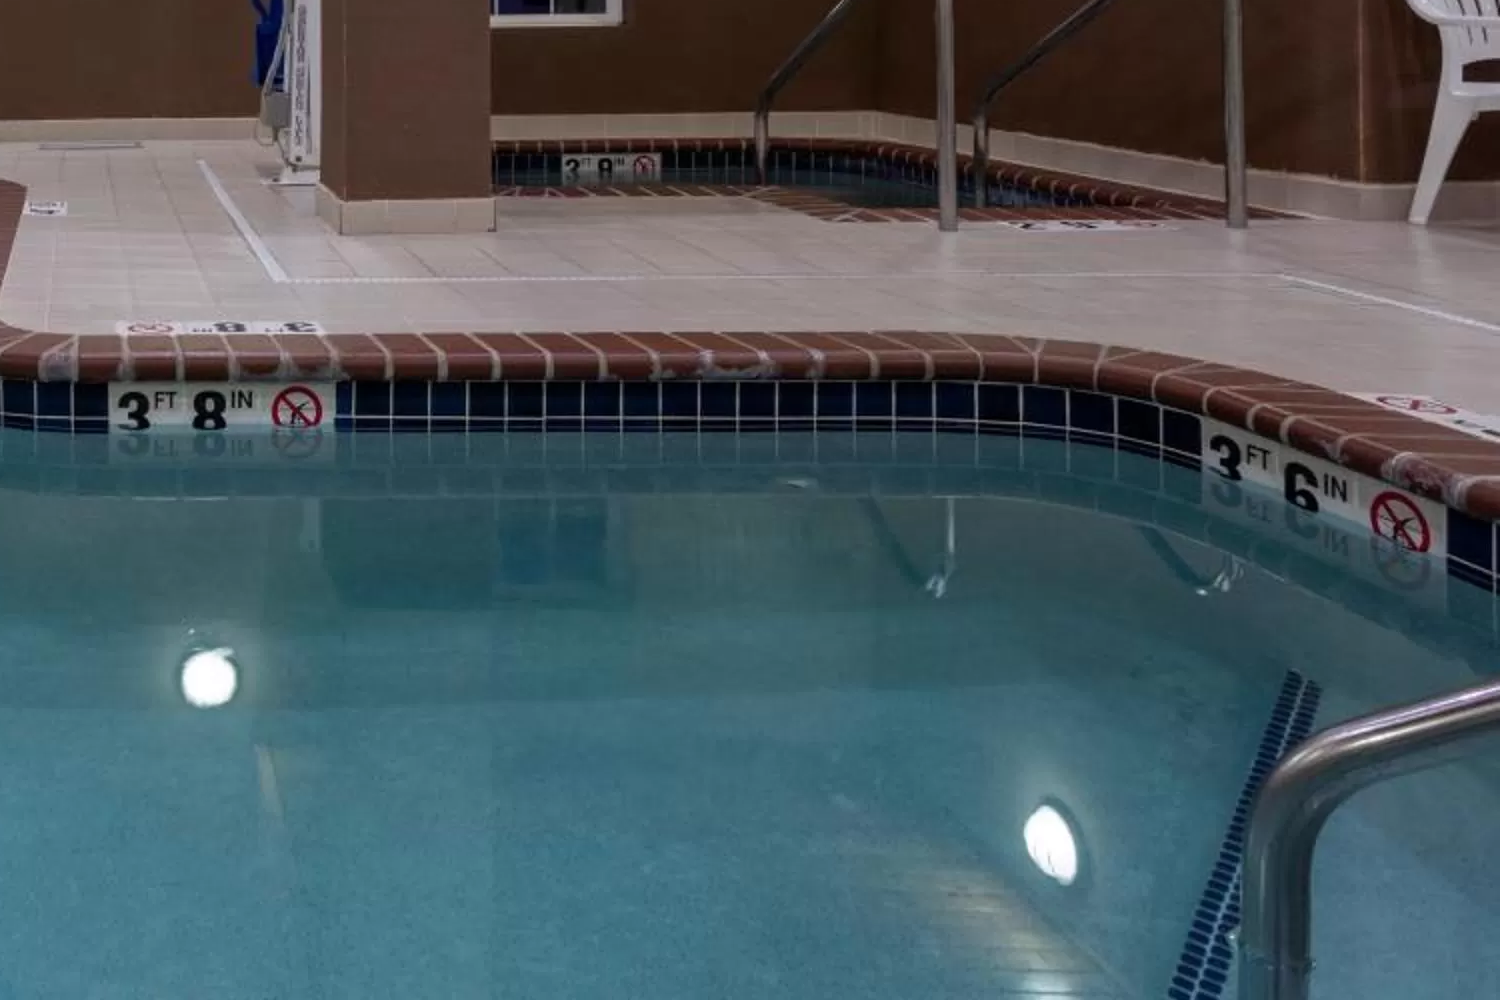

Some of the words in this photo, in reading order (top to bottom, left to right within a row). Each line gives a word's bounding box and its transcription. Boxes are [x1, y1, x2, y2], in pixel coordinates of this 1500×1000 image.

[118, 391, 151, 431] 3
[154, 391, 177, 409] FT
[192, 390, 227, 431] 8
[231, 391, 253, 409] IN
[1209, 434, 1242, 481] 3
[1247, 446, 1270, 471] FT
[1284, 461, 1319, 513] 6
[1323, 473, 1347, 503] IN
